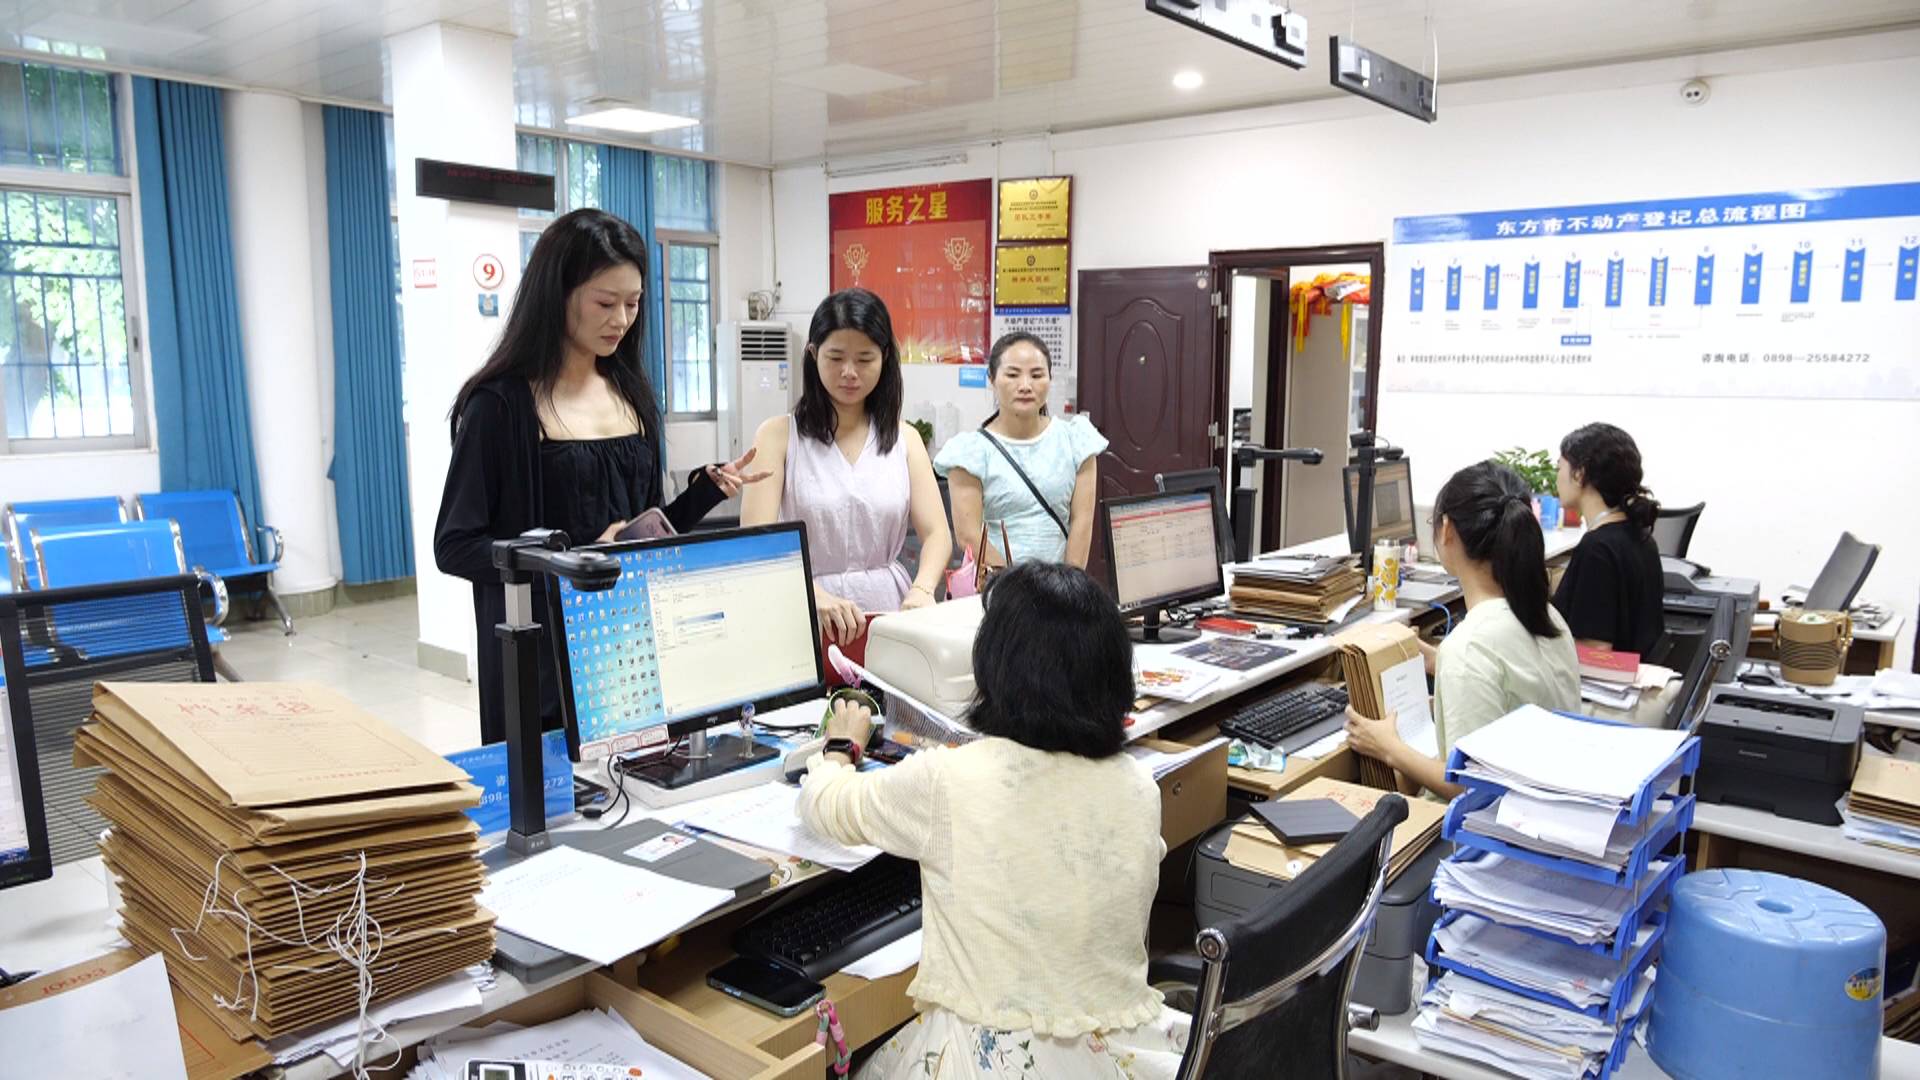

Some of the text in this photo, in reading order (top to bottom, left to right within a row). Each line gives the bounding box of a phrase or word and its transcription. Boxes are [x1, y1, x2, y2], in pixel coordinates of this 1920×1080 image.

[866, 191, 948, 225] 服务之星
[1496, 202, 1807, 236] 东方市不动产登记总流程图
[1798, 241, 1811, 249] 10
[1851, 238, 1863, 246] 11
[1904, 236, 1917, 244] 12
[483, 263, 496, 280] 9
